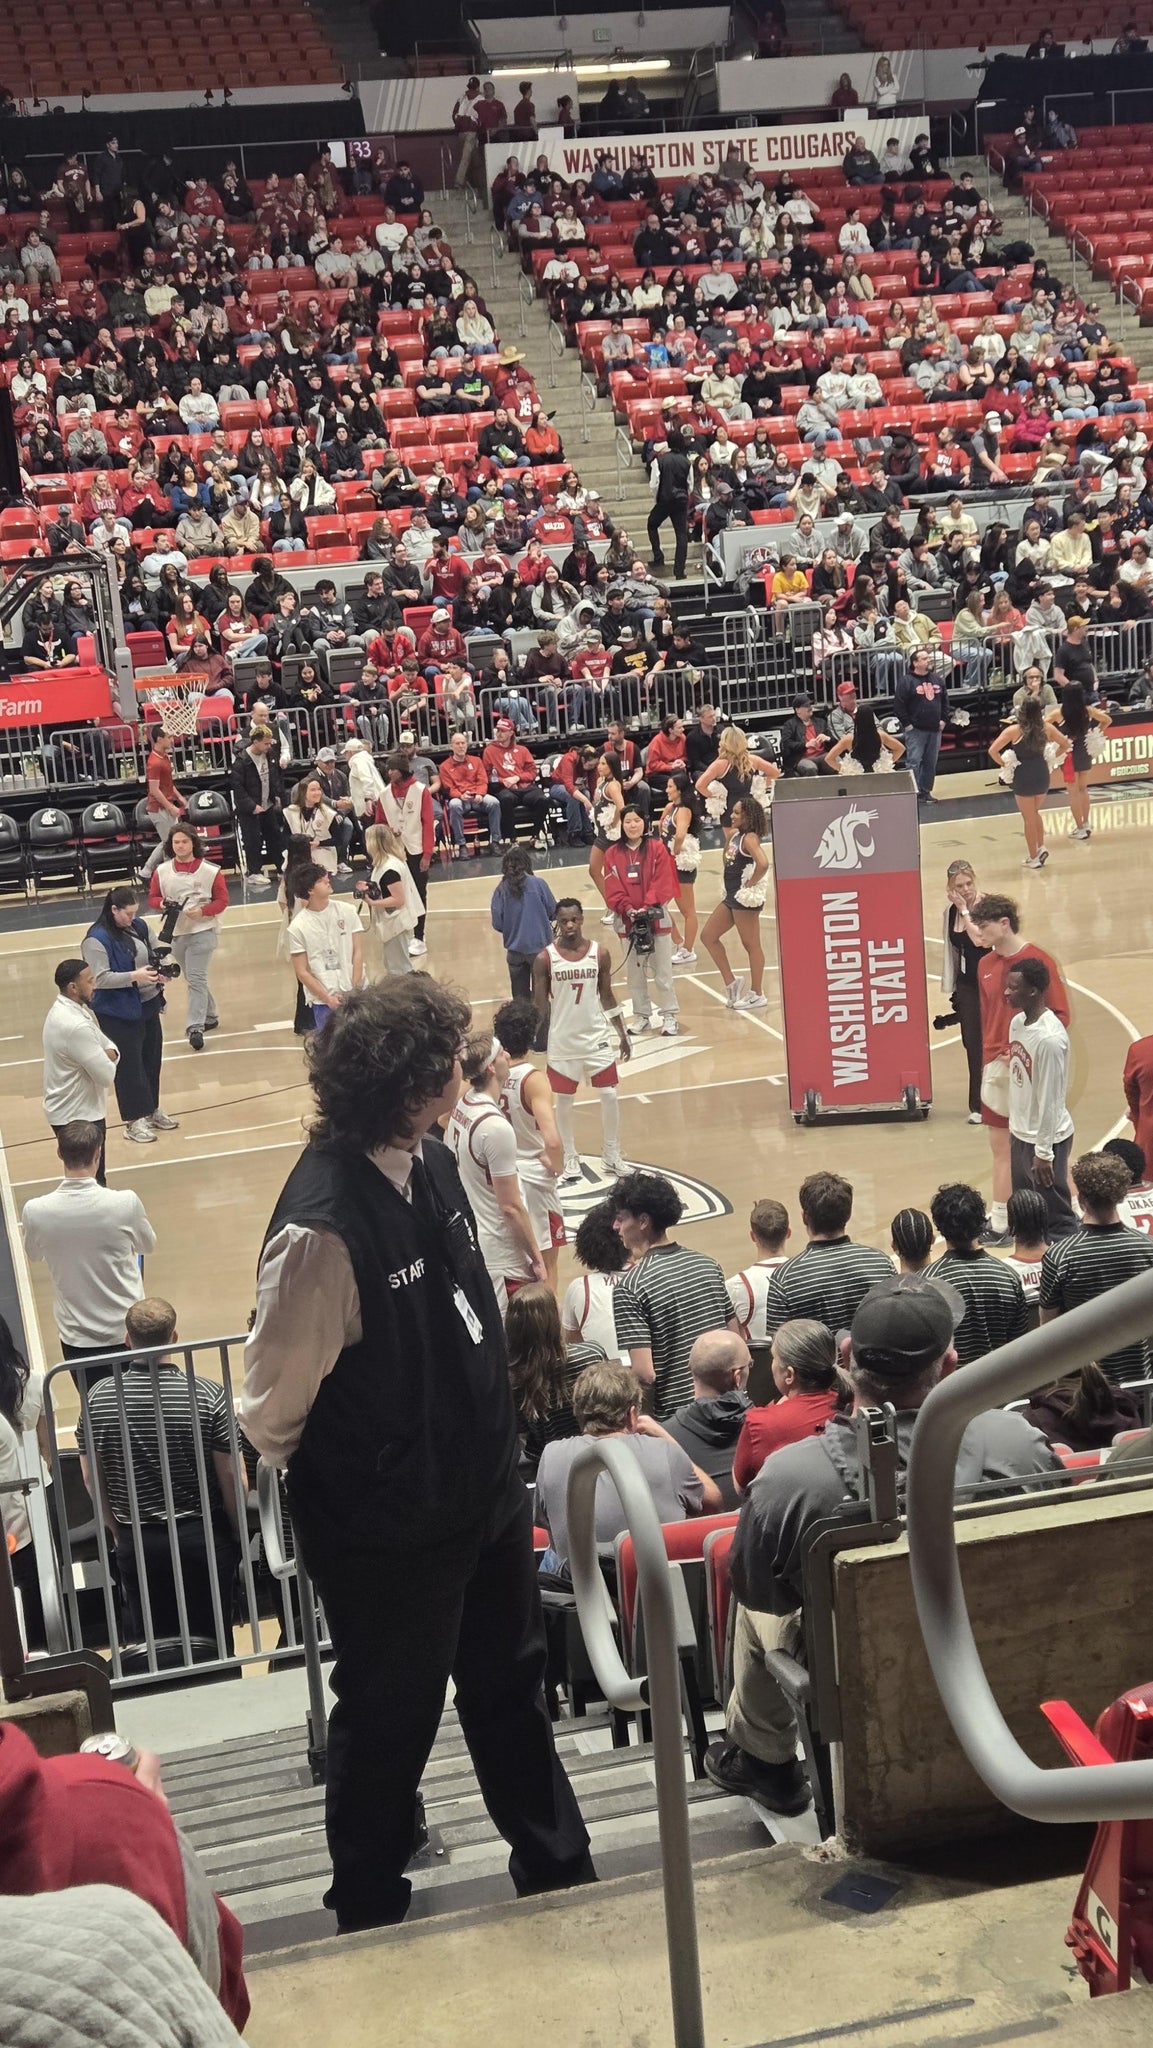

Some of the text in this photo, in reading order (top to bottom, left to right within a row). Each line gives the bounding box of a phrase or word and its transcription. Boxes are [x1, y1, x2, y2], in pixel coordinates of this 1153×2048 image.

[353, 141, 371, 158] 33
[563, 131, 856, 174] WASHINGTON STATE COUGARS
[0, 699, 42, 717] Farm
[1110, 764, 1149, 776] #GOCOUGS
[555, 969, 597, 981] COUGARS
[868, 938, 908, 1025] STATE
[571, 983, 584, 1005] 7
[822, 891, 869, 1087] WASHINGTON
[388, 1258, 425, 1289] STAFF
[1096, 1905, 1111, 1949] G
